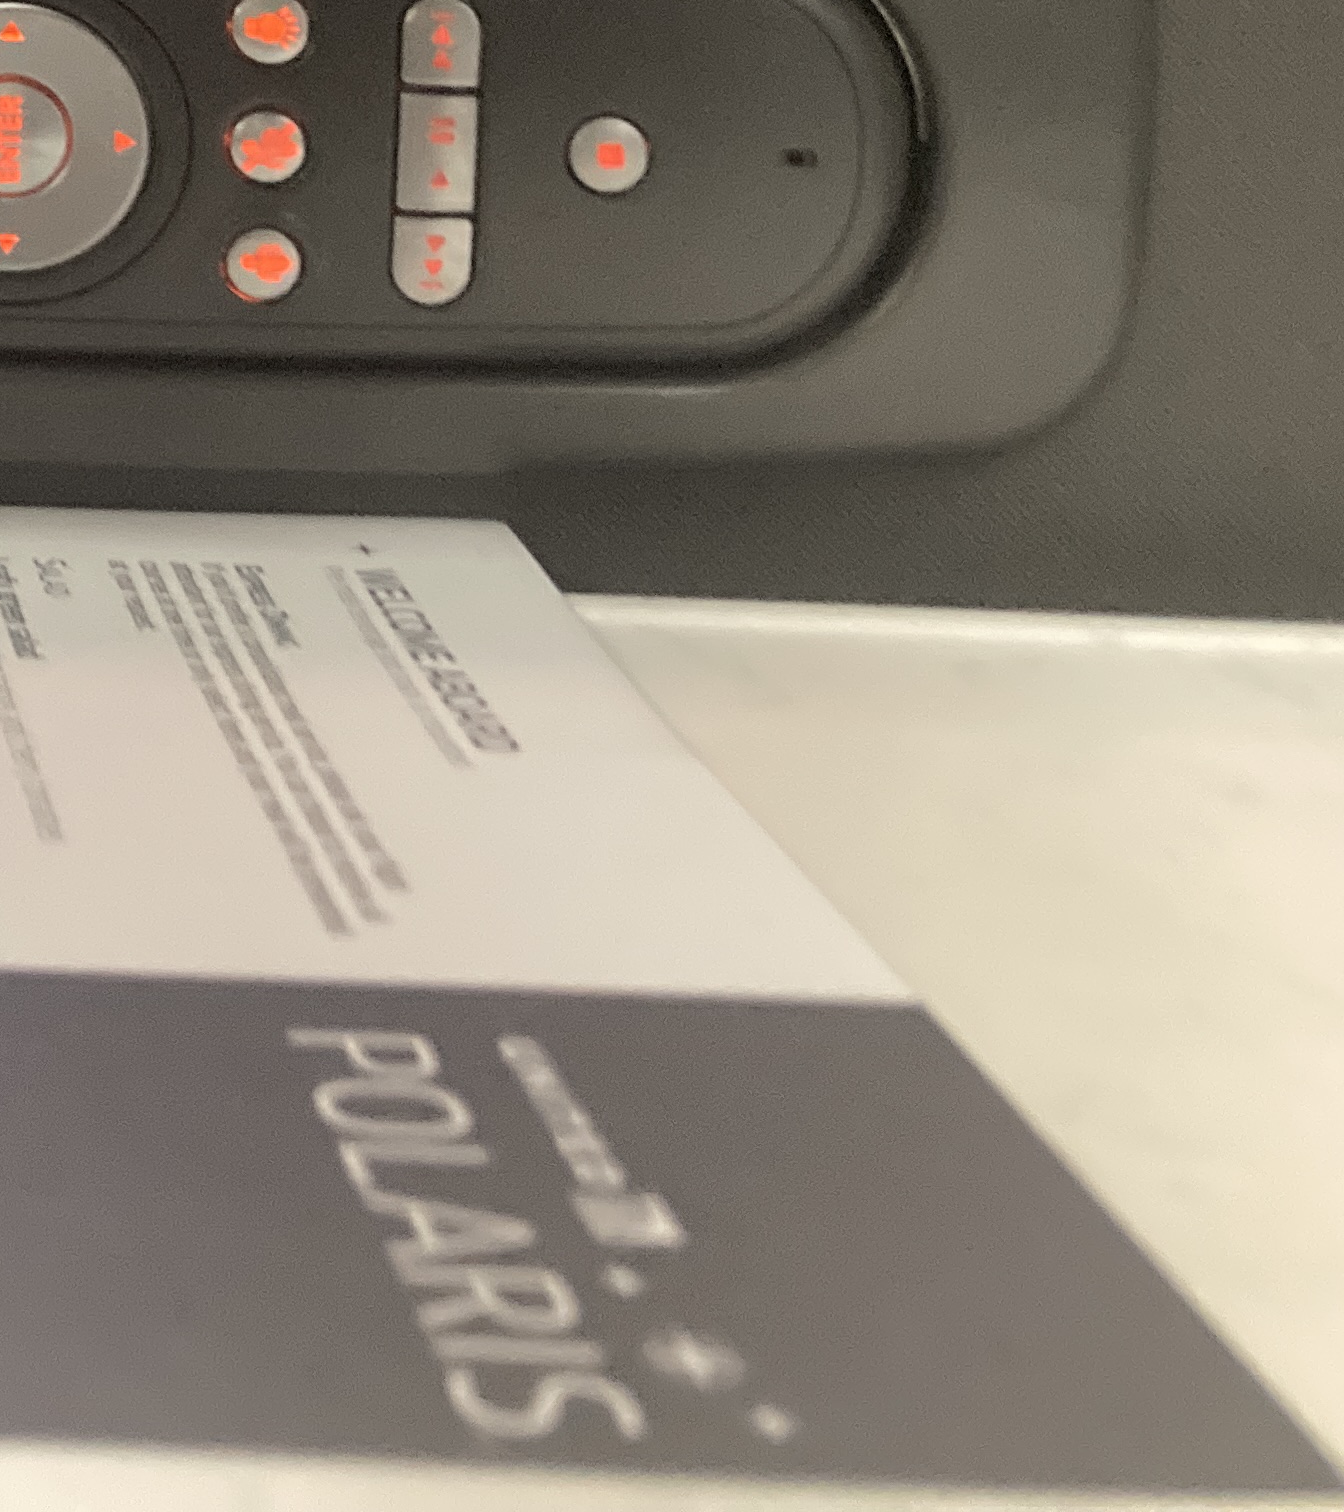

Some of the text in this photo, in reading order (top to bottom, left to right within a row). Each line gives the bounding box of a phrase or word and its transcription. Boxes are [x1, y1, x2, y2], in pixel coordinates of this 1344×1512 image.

[358, 569, 454, 661] WELCOME
[423, 668, 519, 751] ABOARD
[286, 1025, 649, 1442] POLARIS
